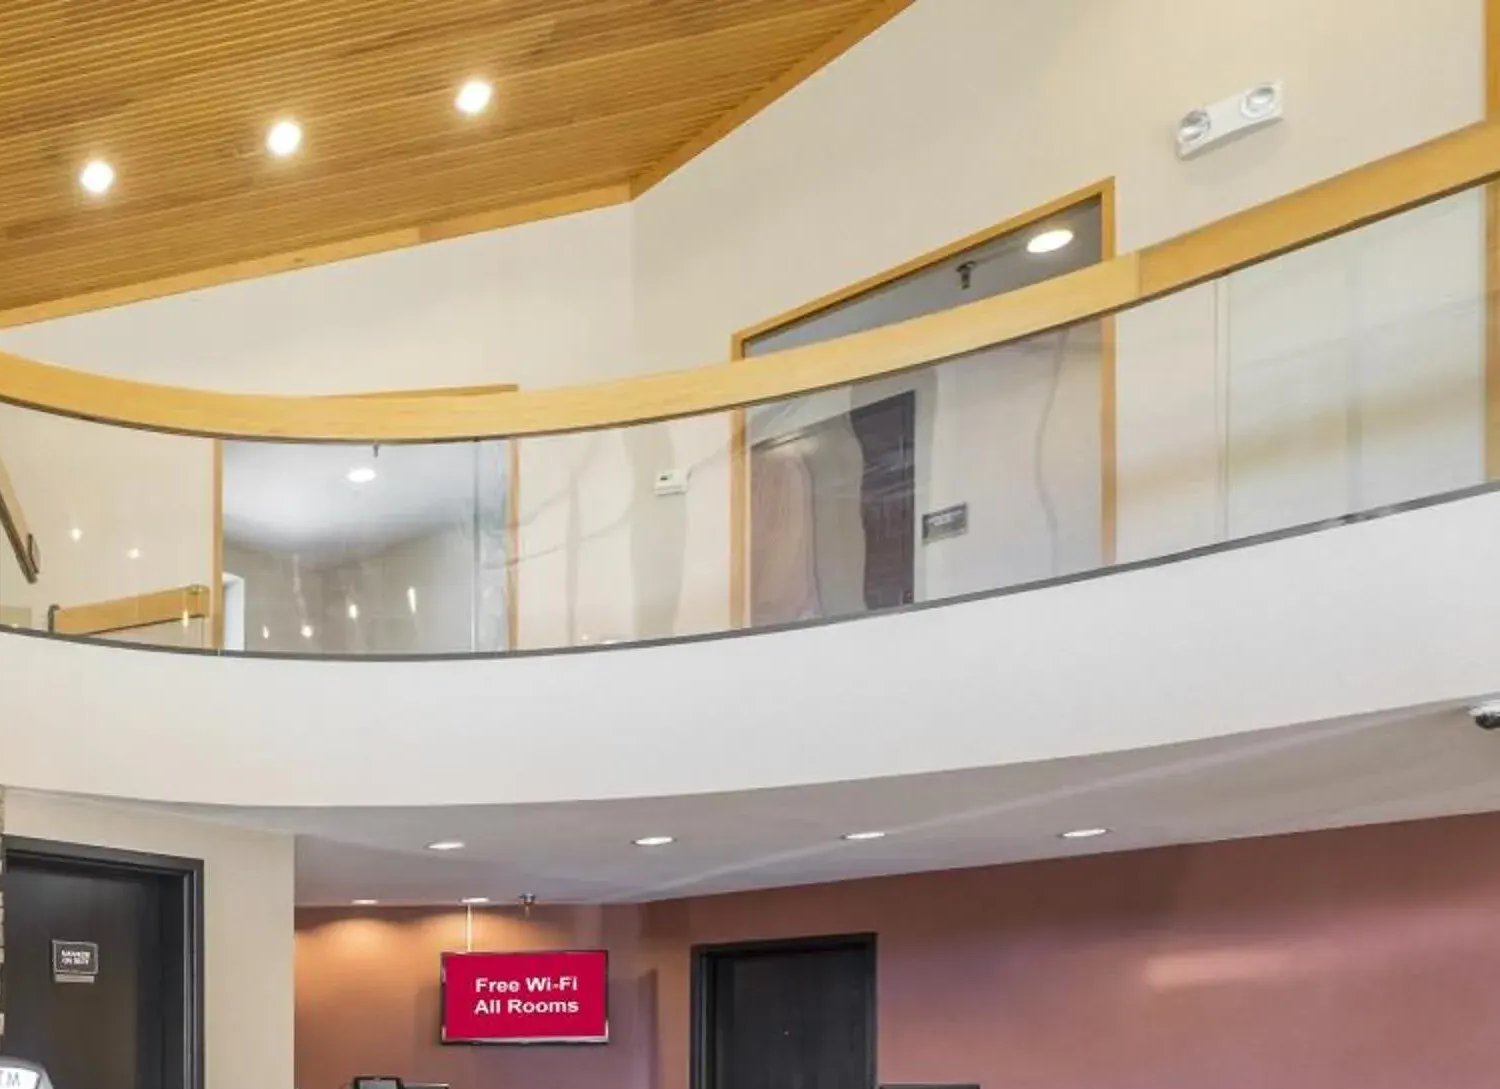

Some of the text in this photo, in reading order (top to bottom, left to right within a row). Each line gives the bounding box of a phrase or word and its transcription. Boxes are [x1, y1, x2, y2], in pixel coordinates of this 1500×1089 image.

[475, 975, 579, 993] Free Wi-Fi
[474, 999, 580, 1014] All Rooms
